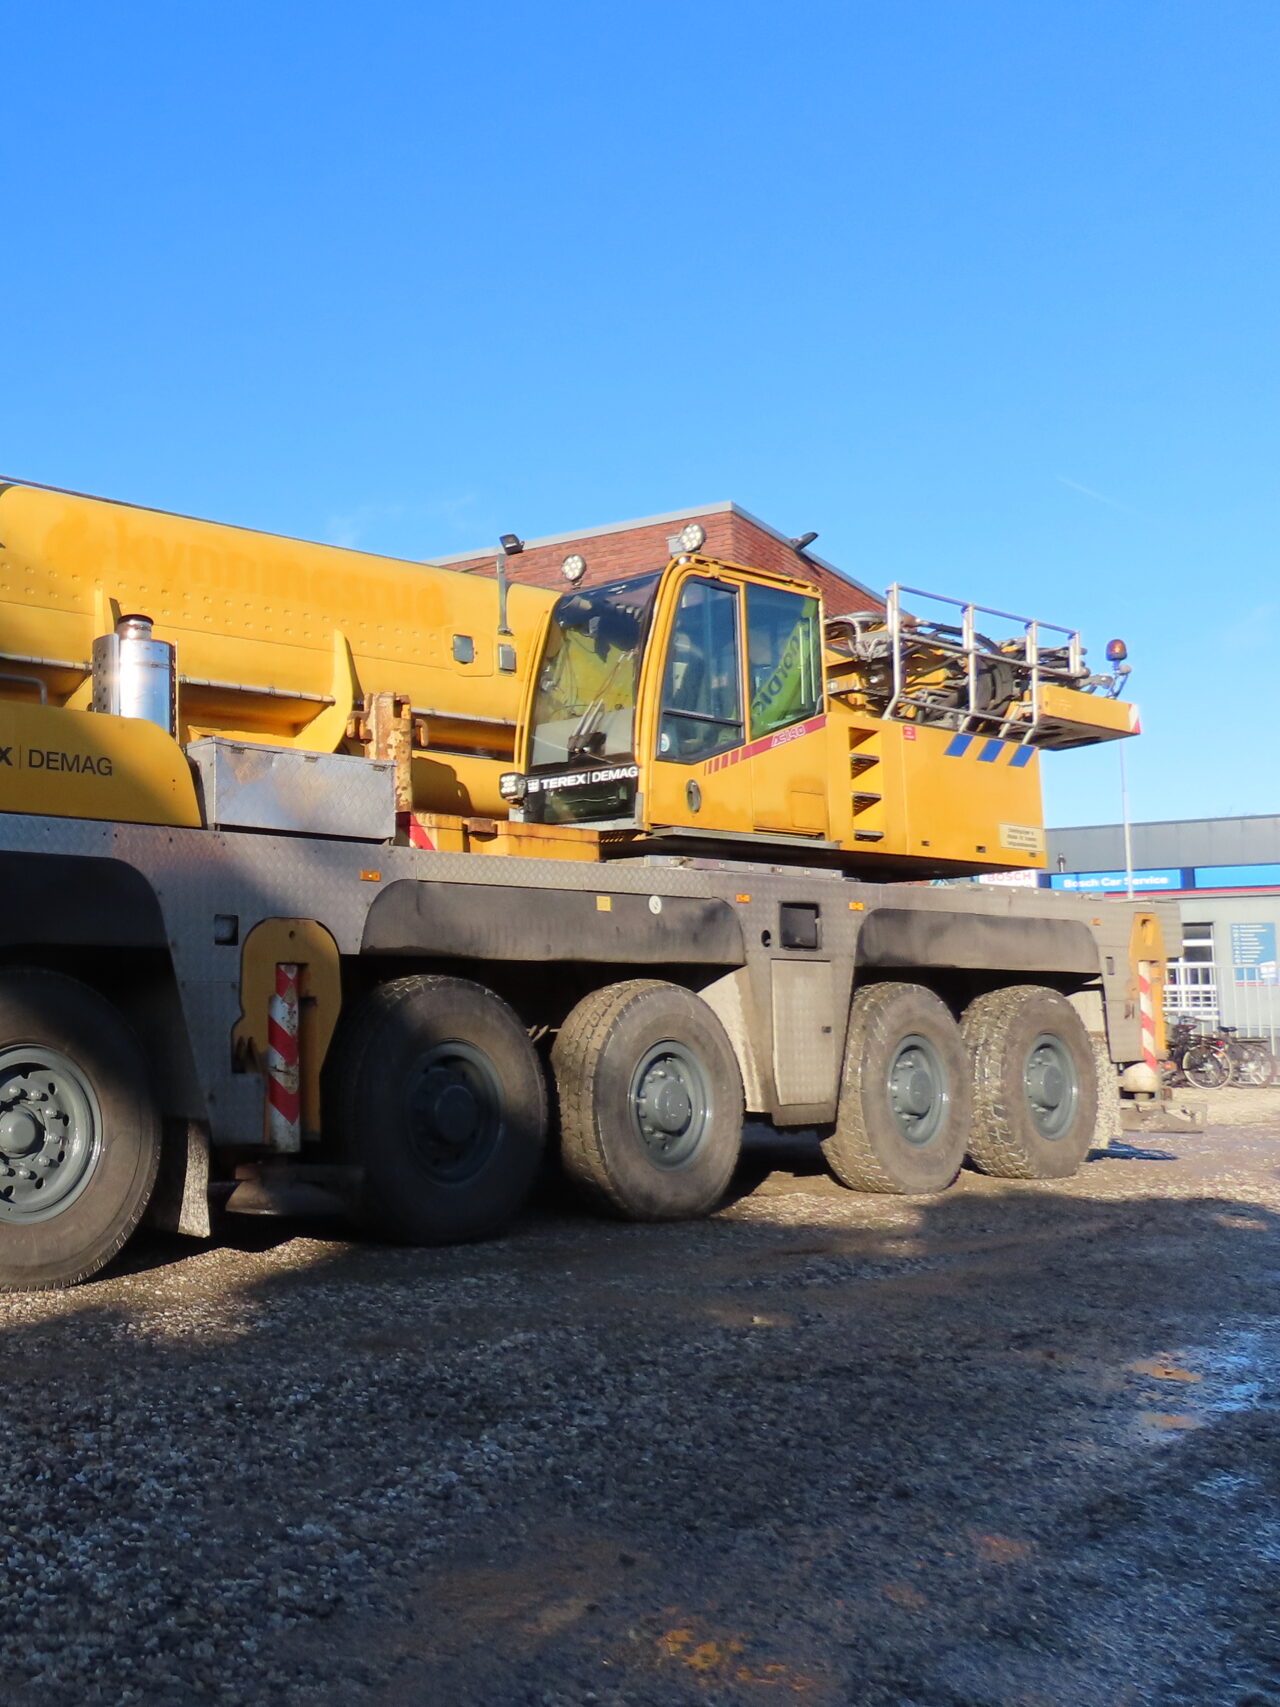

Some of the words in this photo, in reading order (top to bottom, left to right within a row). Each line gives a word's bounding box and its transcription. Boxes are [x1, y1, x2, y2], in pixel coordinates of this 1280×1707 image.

[28, 749, 113, 776] DEMAG
[541, 774, 586, 790] TEREX
[592, 766, 639, 783] DEMAG
[987, 871, 1032, 882] BOSCH
[1063, 876, 1099, 888] Bosch
[1101, 876, 1122, 887] Car
